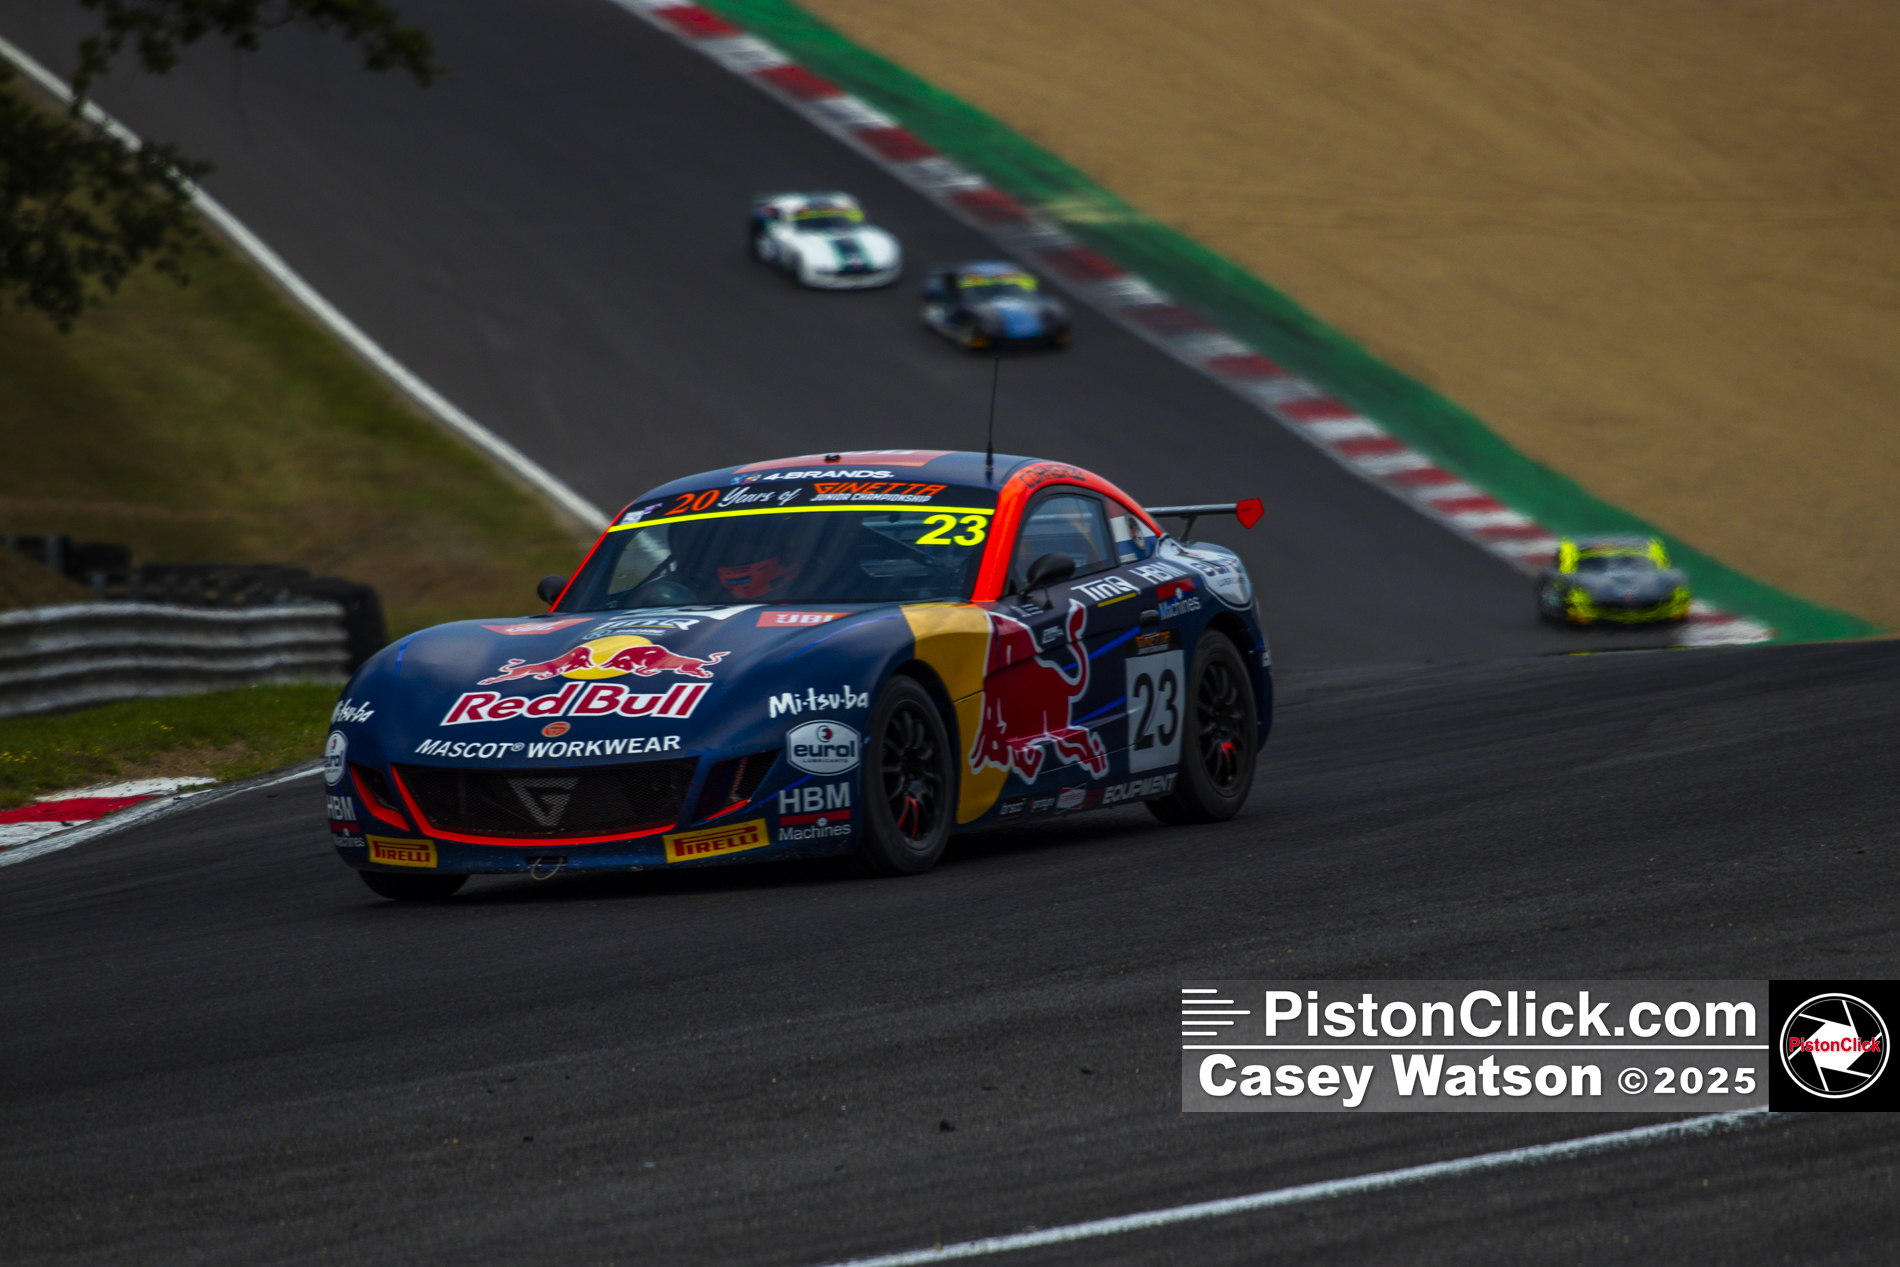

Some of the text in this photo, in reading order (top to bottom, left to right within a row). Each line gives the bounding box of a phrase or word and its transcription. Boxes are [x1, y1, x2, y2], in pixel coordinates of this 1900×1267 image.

[809, 493, 933, 503] JUNIOR CHAMPIONSHIP
[813, 482, 948, 496] GINETTA
[664, 489, 720, 516] 20
[717, 486, 776, 507] Years
[777, 488, 803, 506] of
[915, 514, 988, 546] 23
[1128, 562, 1187, 585] HBM
[1132, 668, 1178, 751] 23
[527, 735, 681, 758] WORKWEAR
[794, 741, 855, 757] eurol
[327, 795, 358, 821] HBM
[778, 782, 850, 814] HBM
[674, 825, 759, 857] PIRELLI
[778, 824, 851, 841] Machines
[373, 841, 430, 862] PIRELLI
